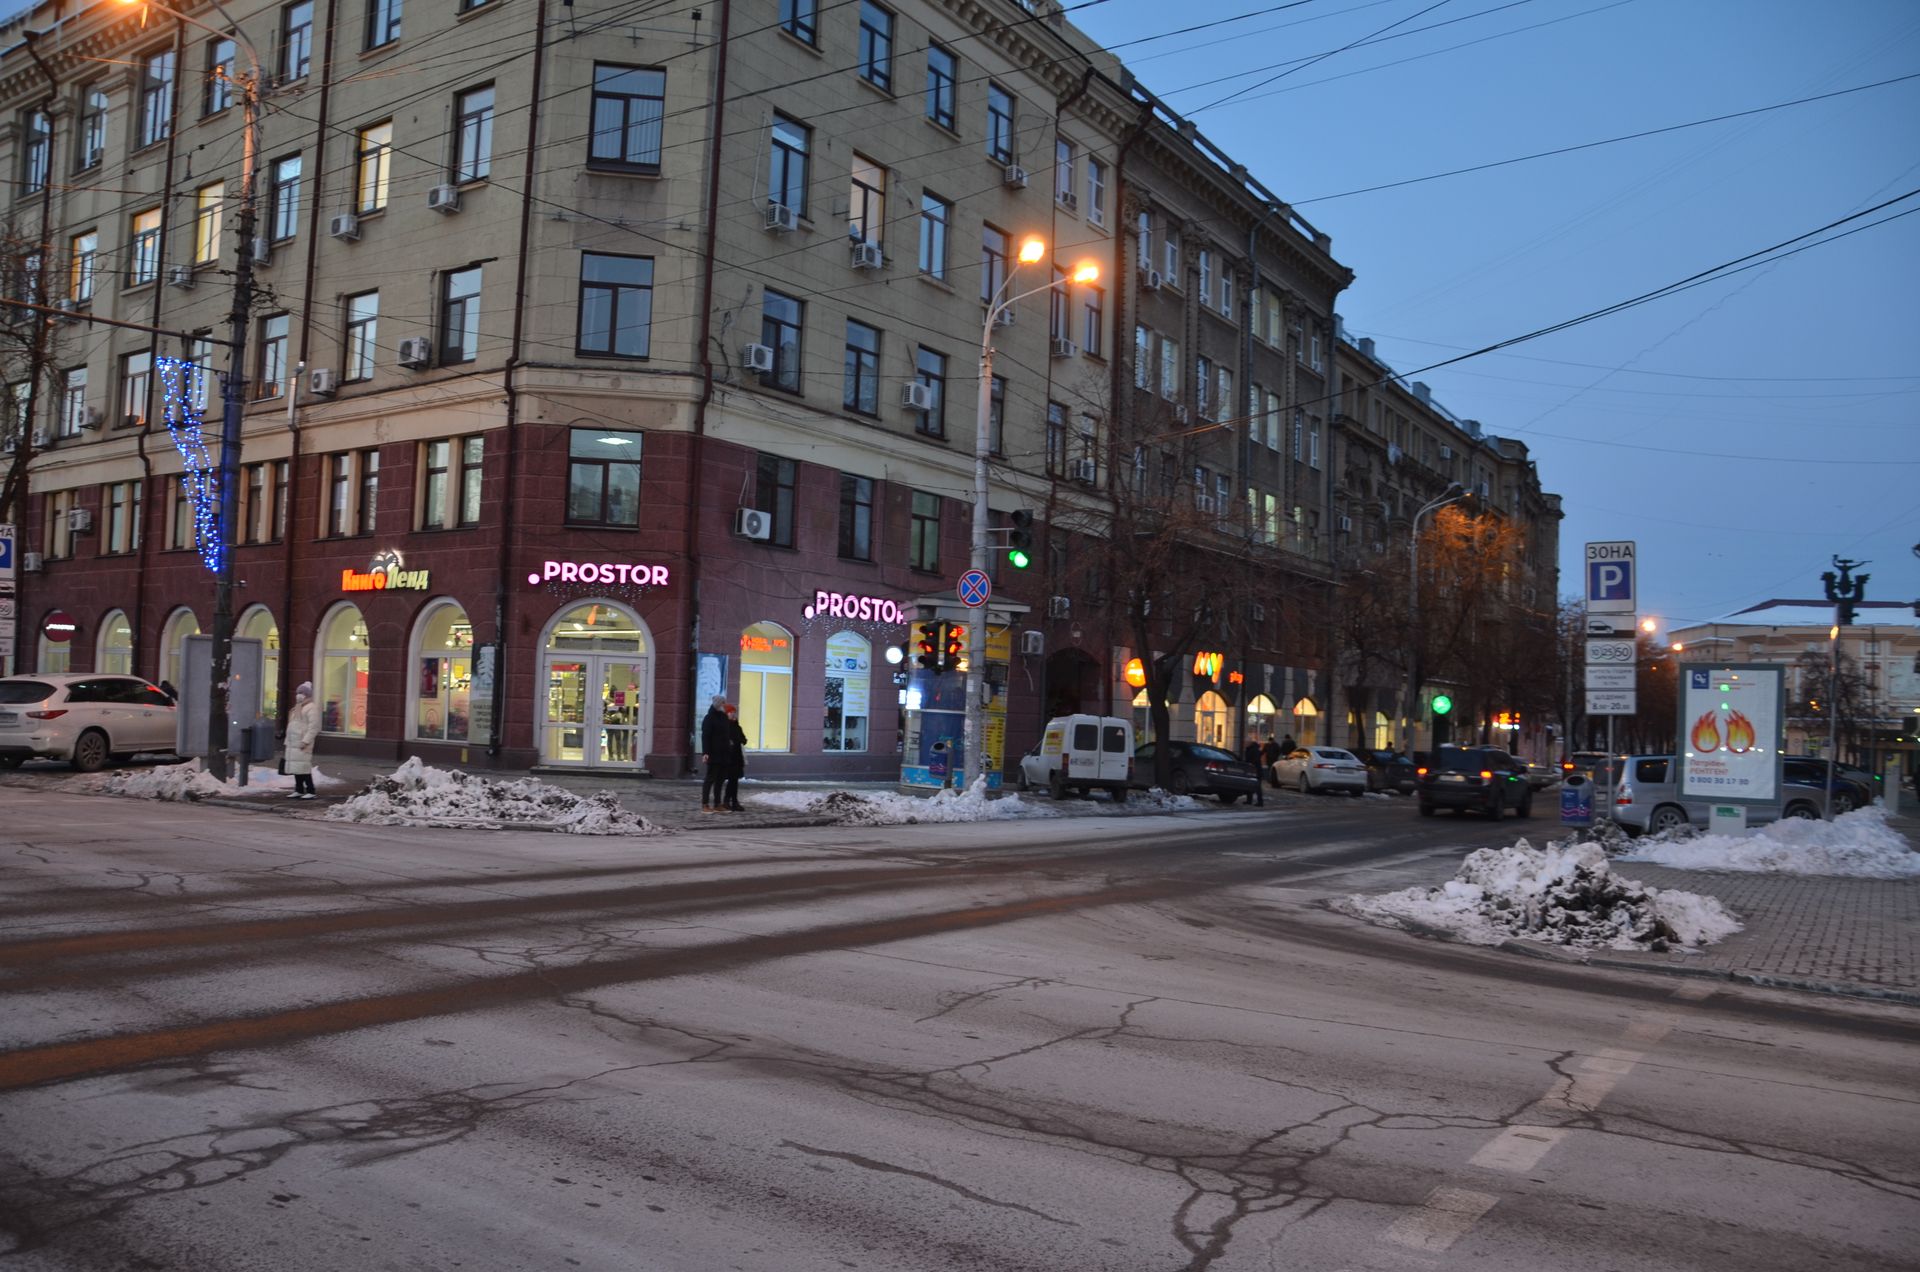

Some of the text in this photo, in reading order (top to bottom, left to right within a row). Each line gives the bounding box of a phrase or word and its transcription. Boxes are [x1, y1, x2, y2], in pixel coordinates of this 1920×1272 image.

[1588, 545, 1633, 559] ЗОНА
[544, 561, 669, 585] PROSTOR
[1600, 565, 1623, 598] P
[1616, 647, 1629, 657] 50
